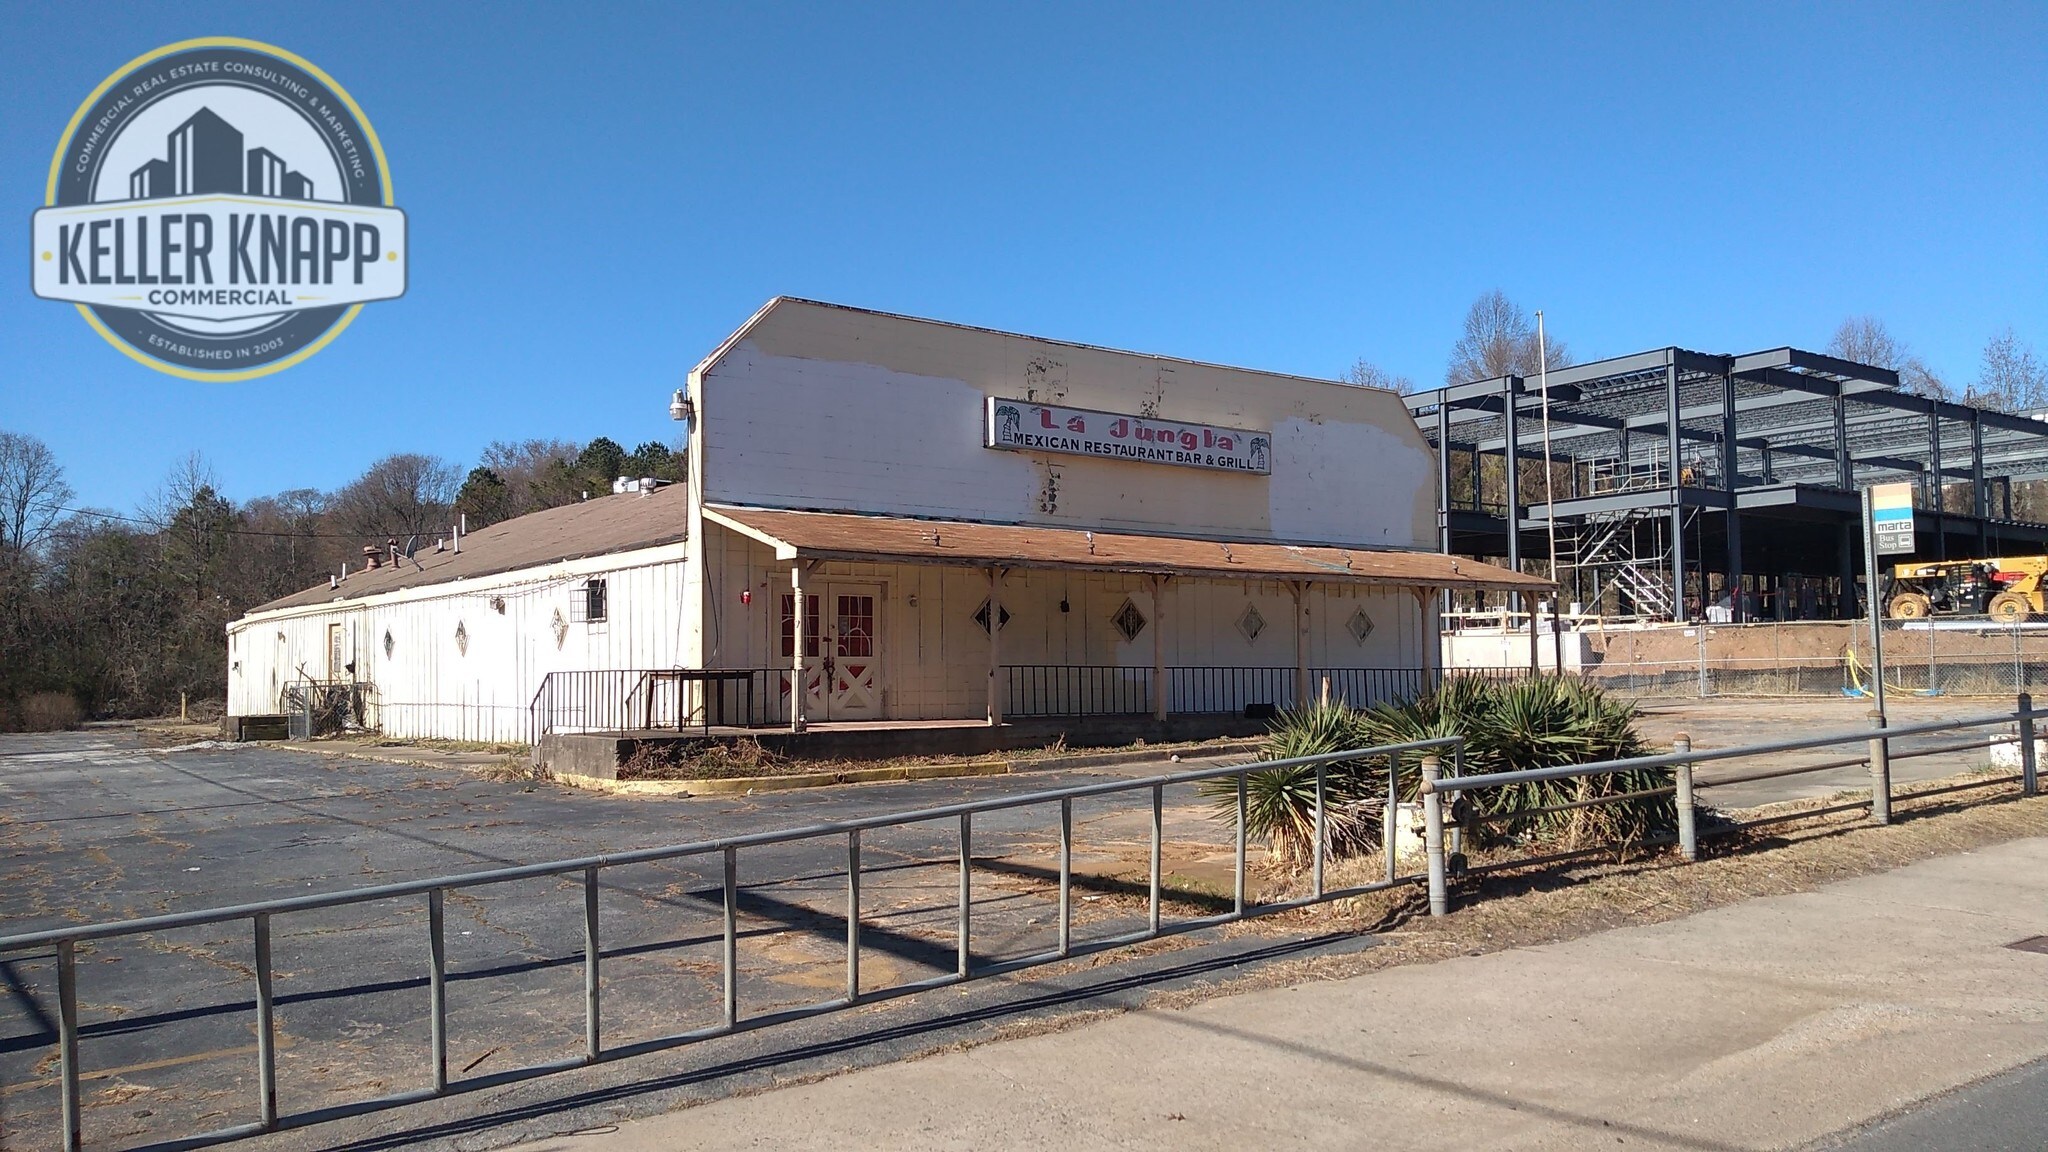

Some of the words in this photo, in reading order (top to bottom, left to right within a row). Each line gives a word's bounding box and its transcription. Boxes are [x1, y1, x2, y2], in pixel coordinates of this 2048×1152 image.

[1040, 409, 1085, 434] La
[1110, 418, 1234, 451] Jungla
[1013, 432, 1079, 451] MEXICAN
[1084, 442, 1174, 462] RESTAURANT
[1175, 452, 1202, 465] BAR
[1205, 454, 1214, 465] &
[1217, 455, 1255, 470] GRILL
[1878, 521, 1912, 531] marta
[1879, 542, 1897, 550] Stop
